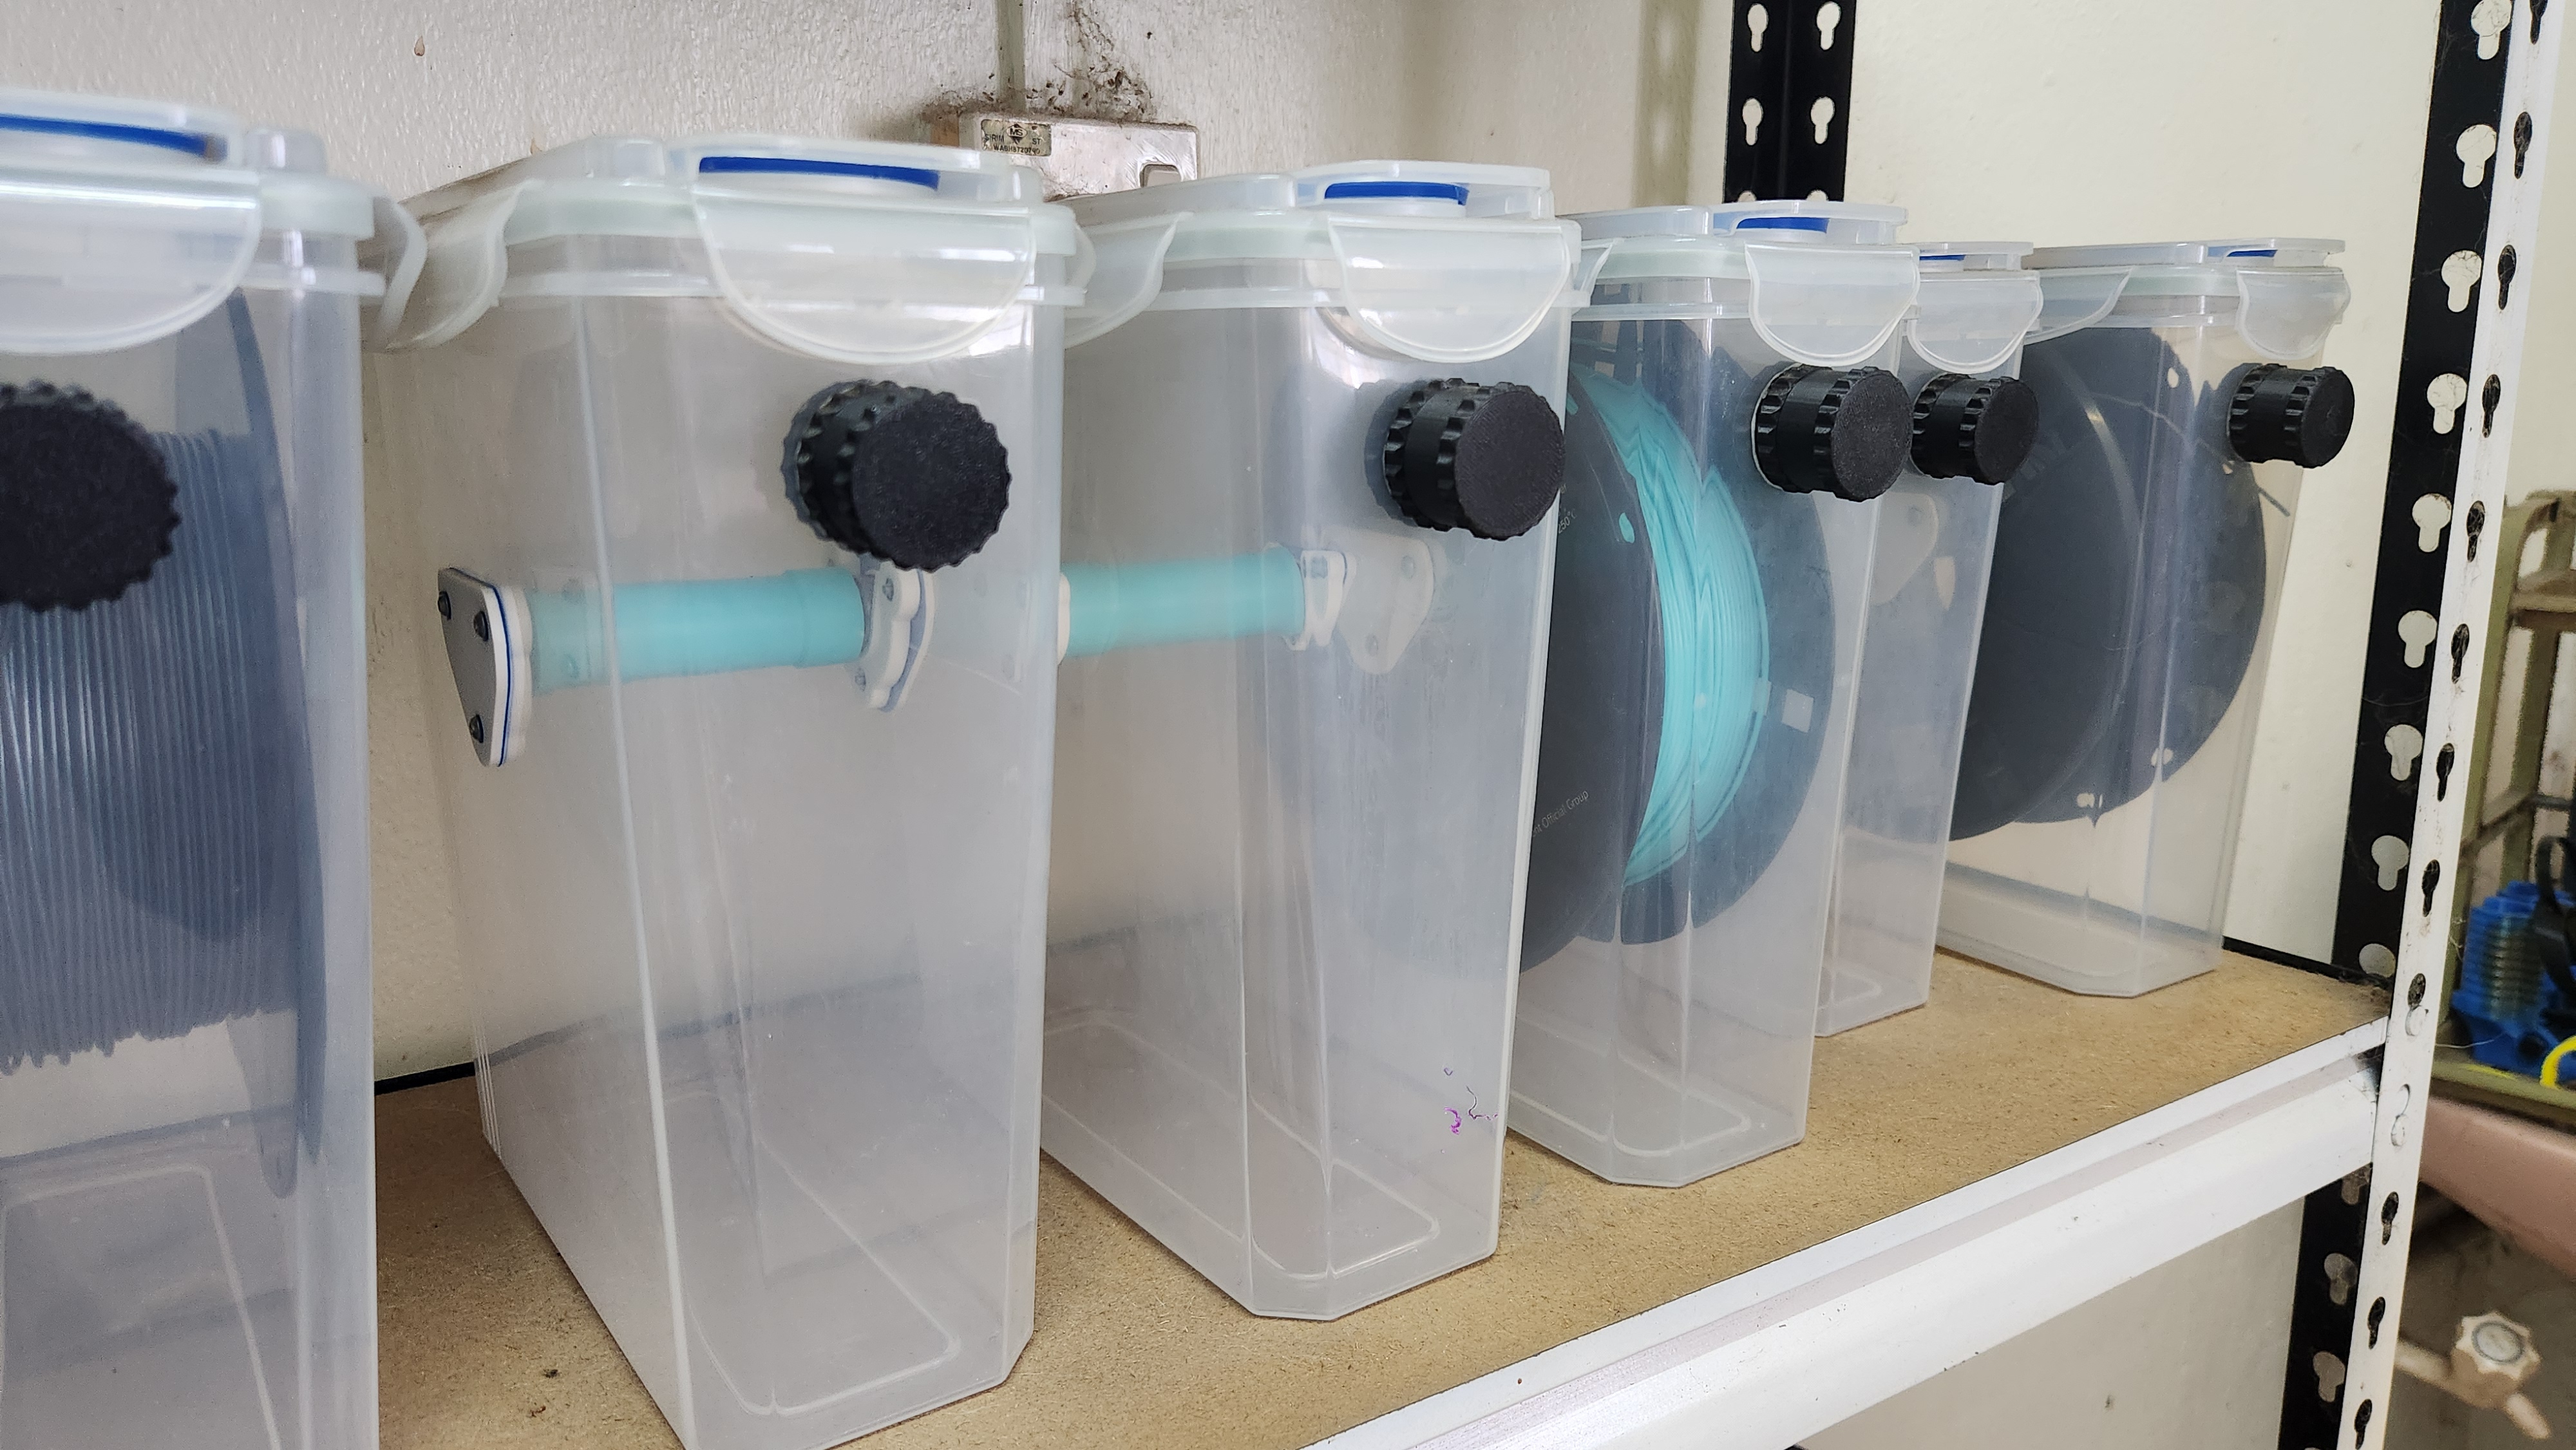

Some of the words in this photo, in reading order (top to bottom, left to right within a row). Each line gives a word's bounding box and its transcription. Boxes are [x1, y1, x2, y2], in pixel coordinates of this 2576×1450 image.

[1010, 127, 1023, 137] MS
[985, 134, 1005, 142] SIRIM
[1542, 804, 1567, 829] Official
[1566, 791, 1589, 810] Group
